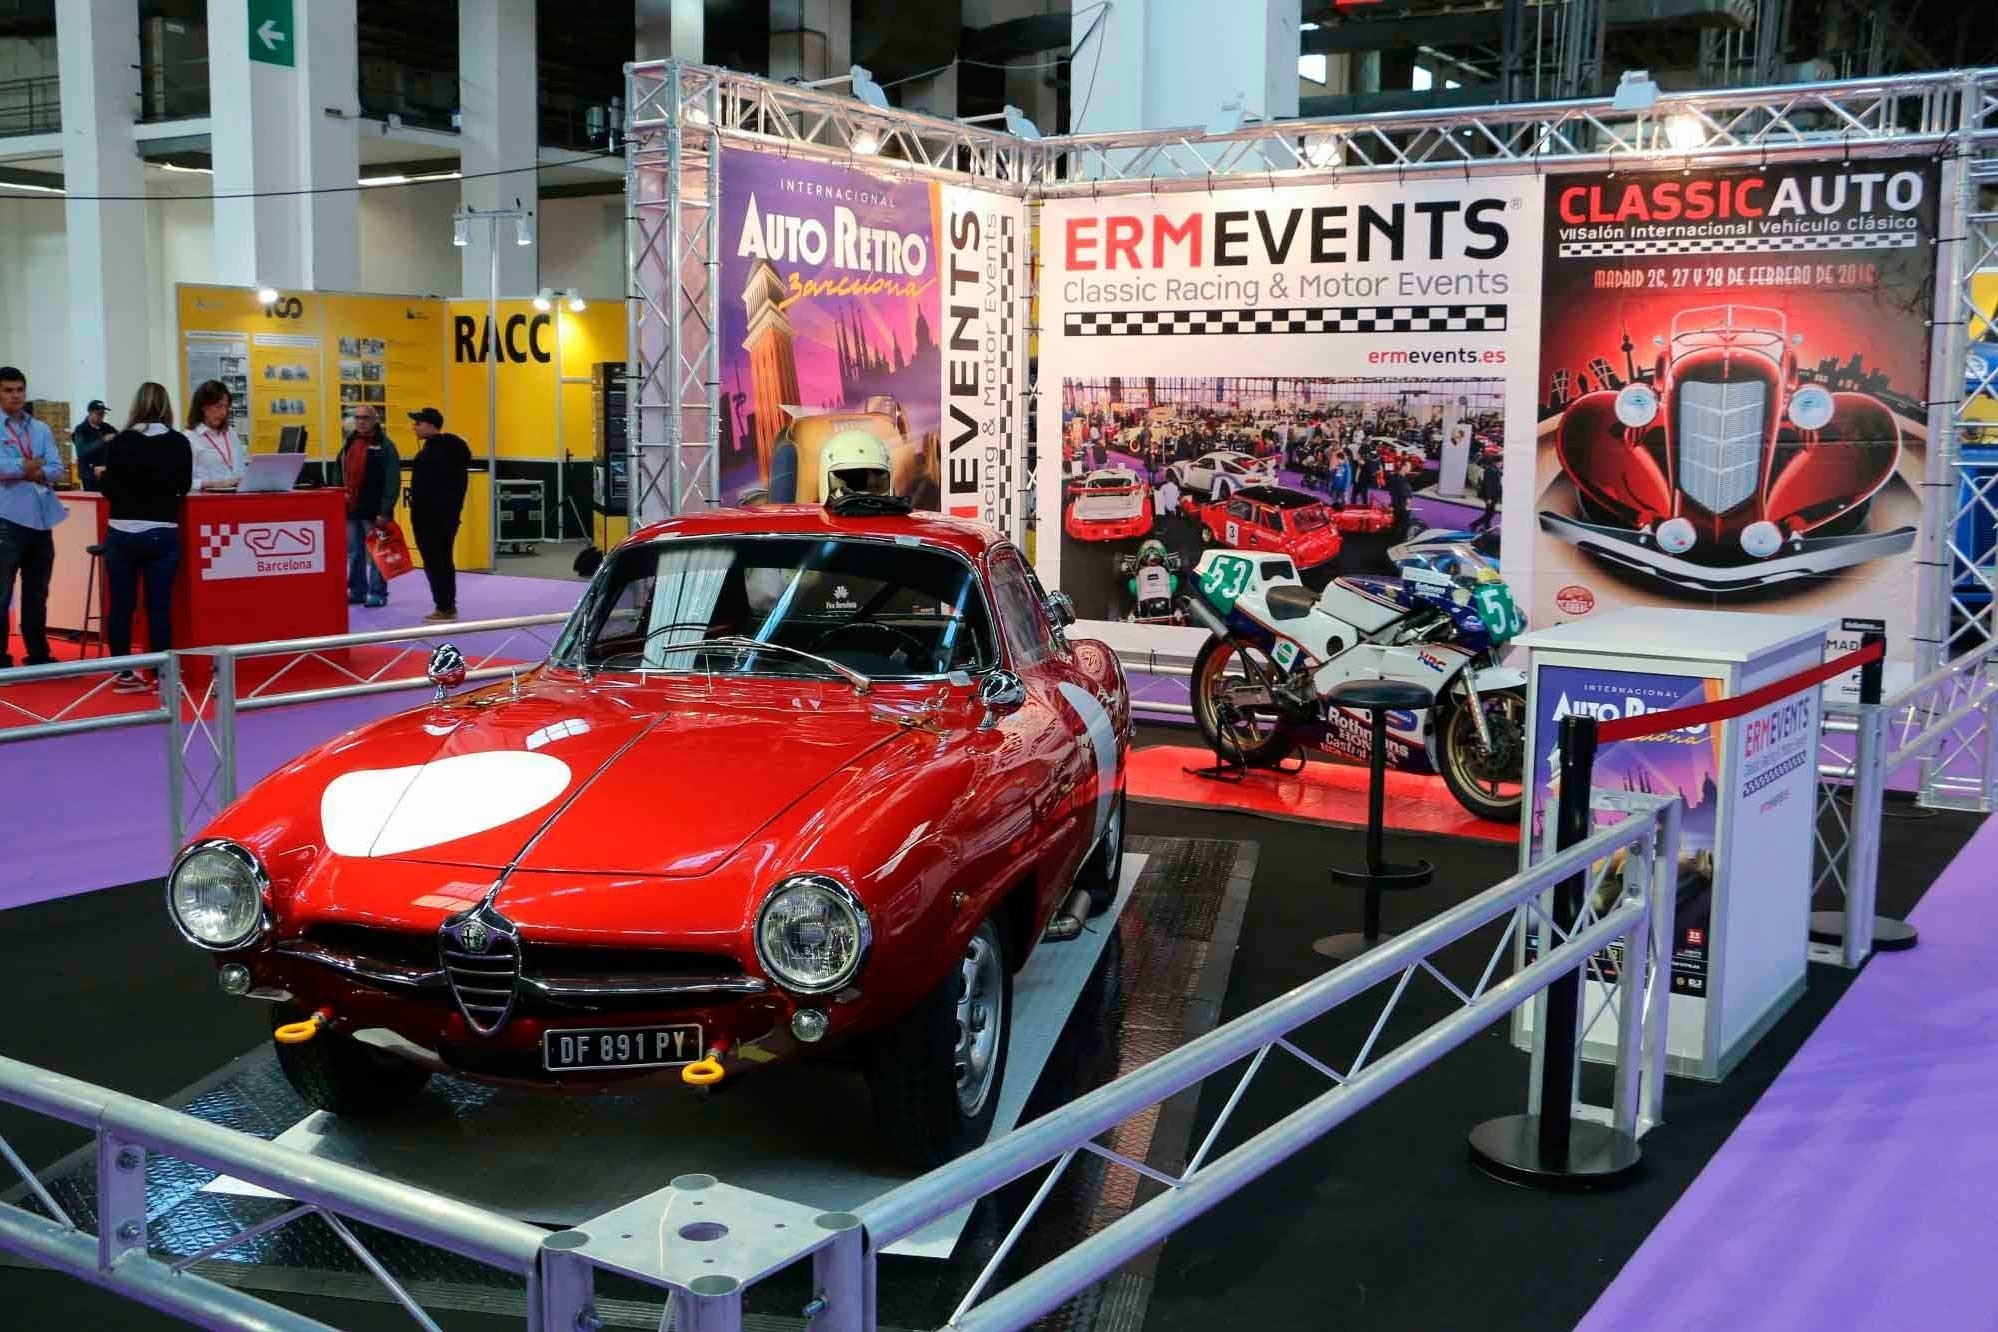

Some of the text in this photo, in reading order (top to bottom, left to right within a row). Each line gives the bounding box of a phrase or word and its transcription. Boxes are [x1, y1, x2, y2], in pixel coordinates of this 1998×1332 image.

[780, 178, 896, 208] INTERNACIONAL
[737, 192, 927, 277] AUTO RETRO
[1065, 197, 1509, 272] ERMEVENTS
[1631, 221, 1752, 238] Internacional
[1760, 217, 1840, 234] Vehículo
[1847, 215, 1918, 231] Clásico
[778, 272, 937, 310] Barcelona
[1064, 267, 1509, 307] Classic Racing & Motor Events
[1594, 267, 1643, 289] MADRID
[1673, 266, 1689, 286] 27
[1706, 265, 1723, 285] 28
[1728, 265, 1744, 285] DE
[1749, 263, 1811, 284] FEBRERO
[1816, 263, 1834, 284] DE
[454, 313, 551, 364] RACC
[1368, 347, 1506, 364] ermevents.es
[949, 210, 980, 517] EVENTS
[982, 213, 999, 534] acing & Motor Events
[1228, 525, 1236, 539] 3
[257, 559, 313, 573] Barcelona
[1203, 557, 1247, 599] 53
[1583, 684, 1679, 698] INTERNACIONAL
[1744, 696, 1810, 758] ERMEVENTS
[560, 1030, 686, 1064] DF 891 PY
